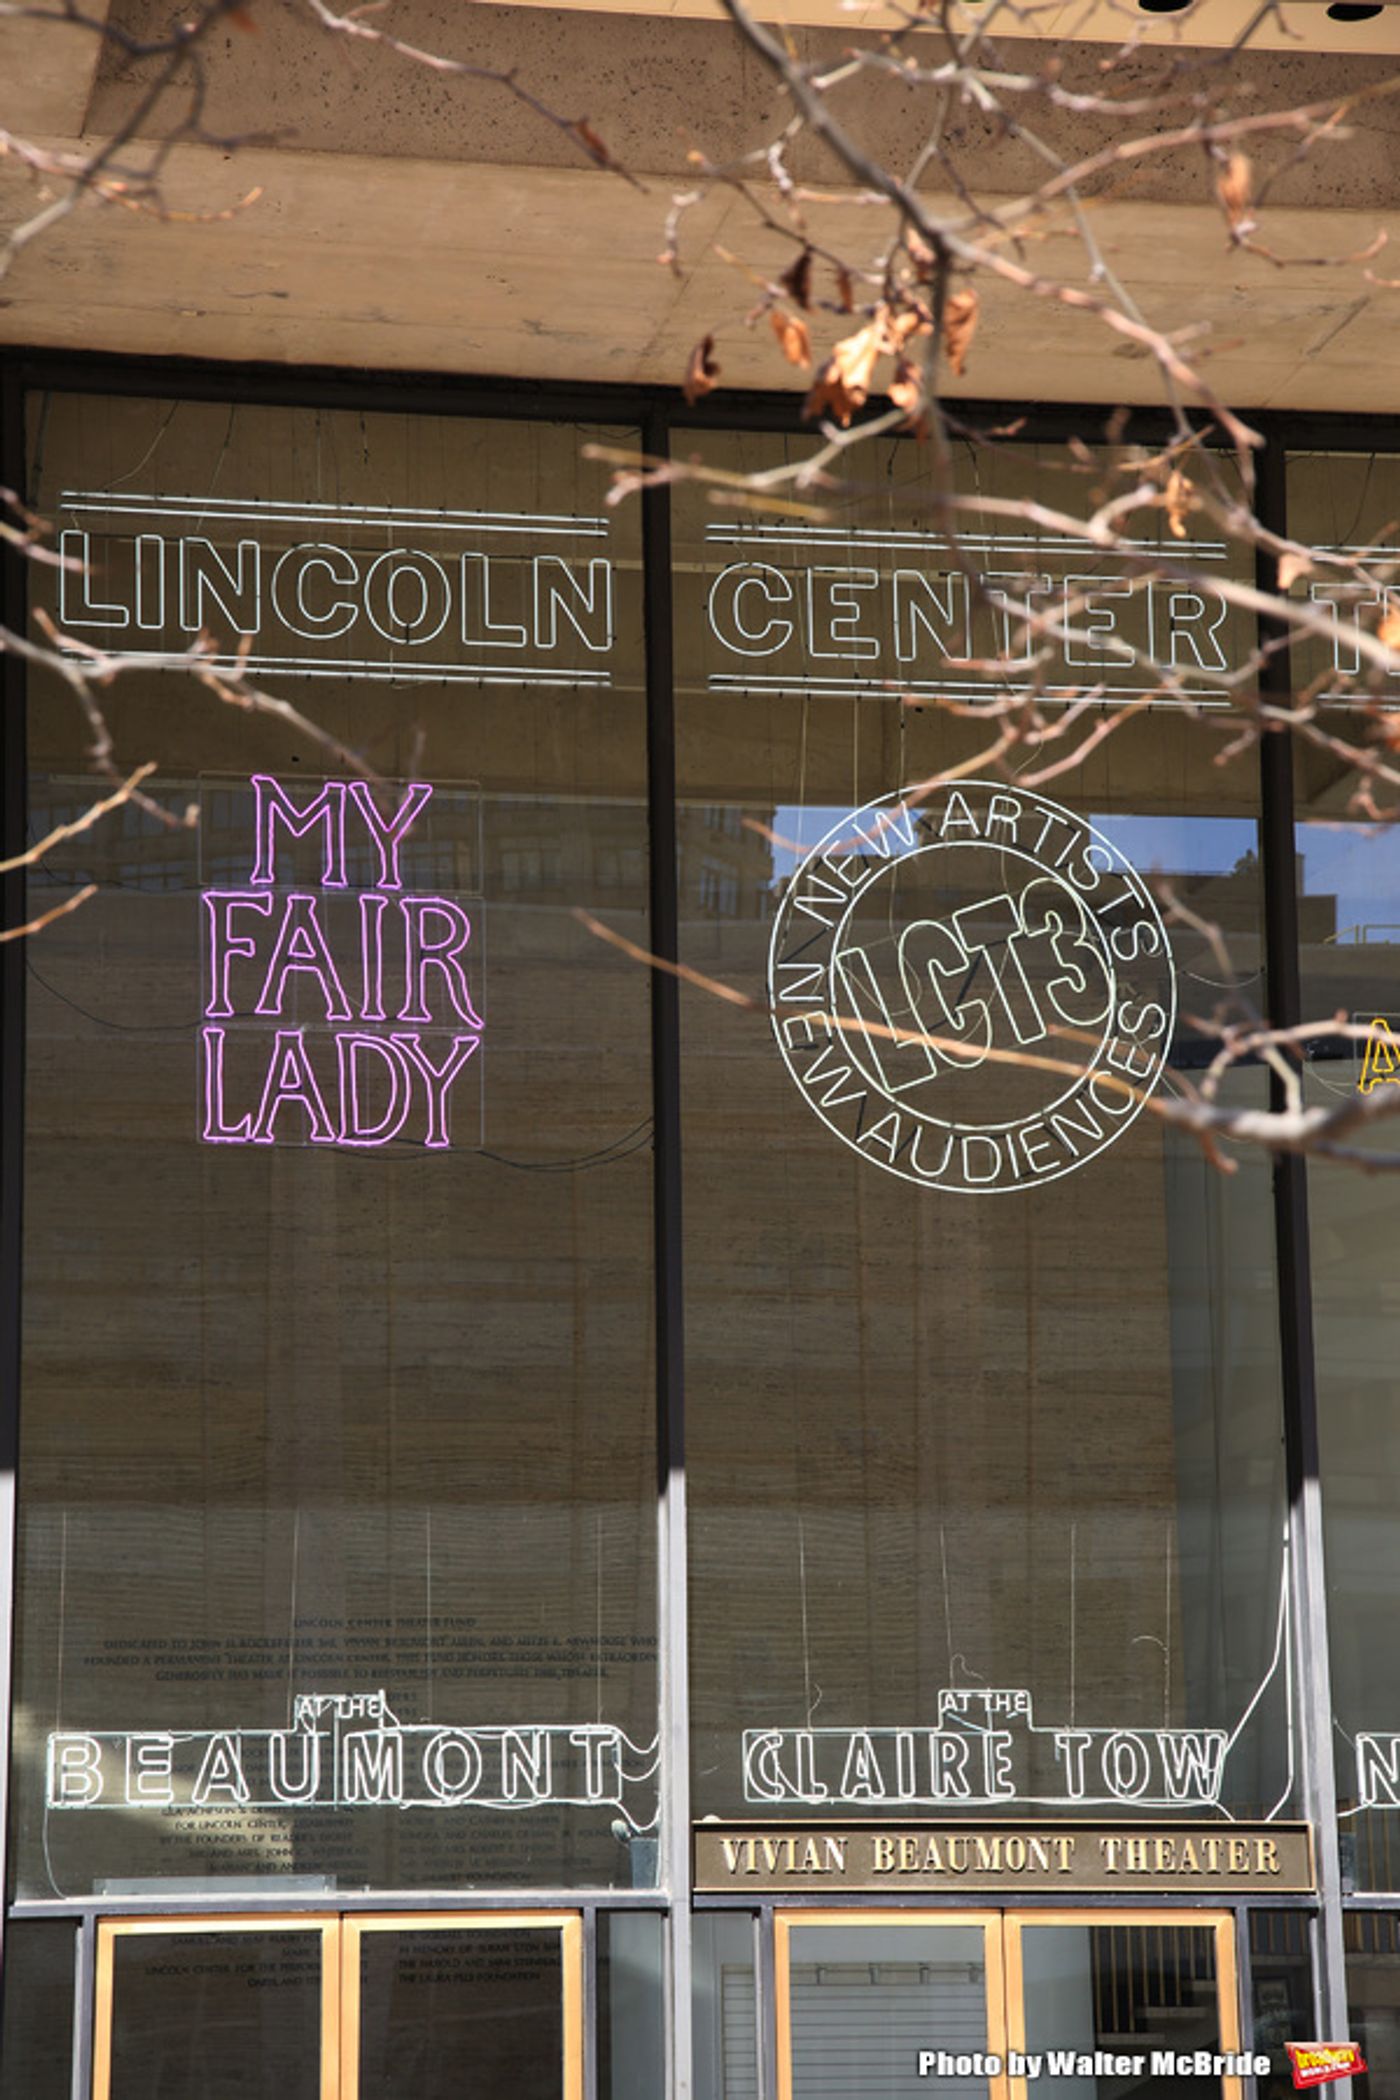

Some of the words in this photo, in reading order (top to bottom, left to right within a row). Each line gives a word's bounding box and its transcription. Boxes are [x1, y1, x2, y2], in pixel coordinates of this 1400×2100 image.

[59, 529, 612, 650] LINCOLN
[708, 561, 1227, 671] CENTER
[250, 774, 434, 890] MY
[793, 800, 915, 928] NEW
[939, 791, 1160, 961] ARTISTS
[202, 890, 485, 1030] FAIR
[835, 876, 1116, 1093] LCT3
[202, 1027, 481, 1148] LADY
[776, 963, 868, 1108] NEW
[856, 1000, 1167, 1182] AUDIENCES
[944, 1692, 972, 1712] AT
[977, 1692, 1028, 1712] THE
[49, 1731, 620, 1803] BEAUMONT
[744, 1731, 1016, 1799] CLAIRE
[1055, 1731, 1225, 1799] TOW
[719, 1837, 848, 1875] VIVIAN
[872, 1836, 1076, 1874] BEAUMONT
[1101, 1836, 1282, 1875] THEATER
